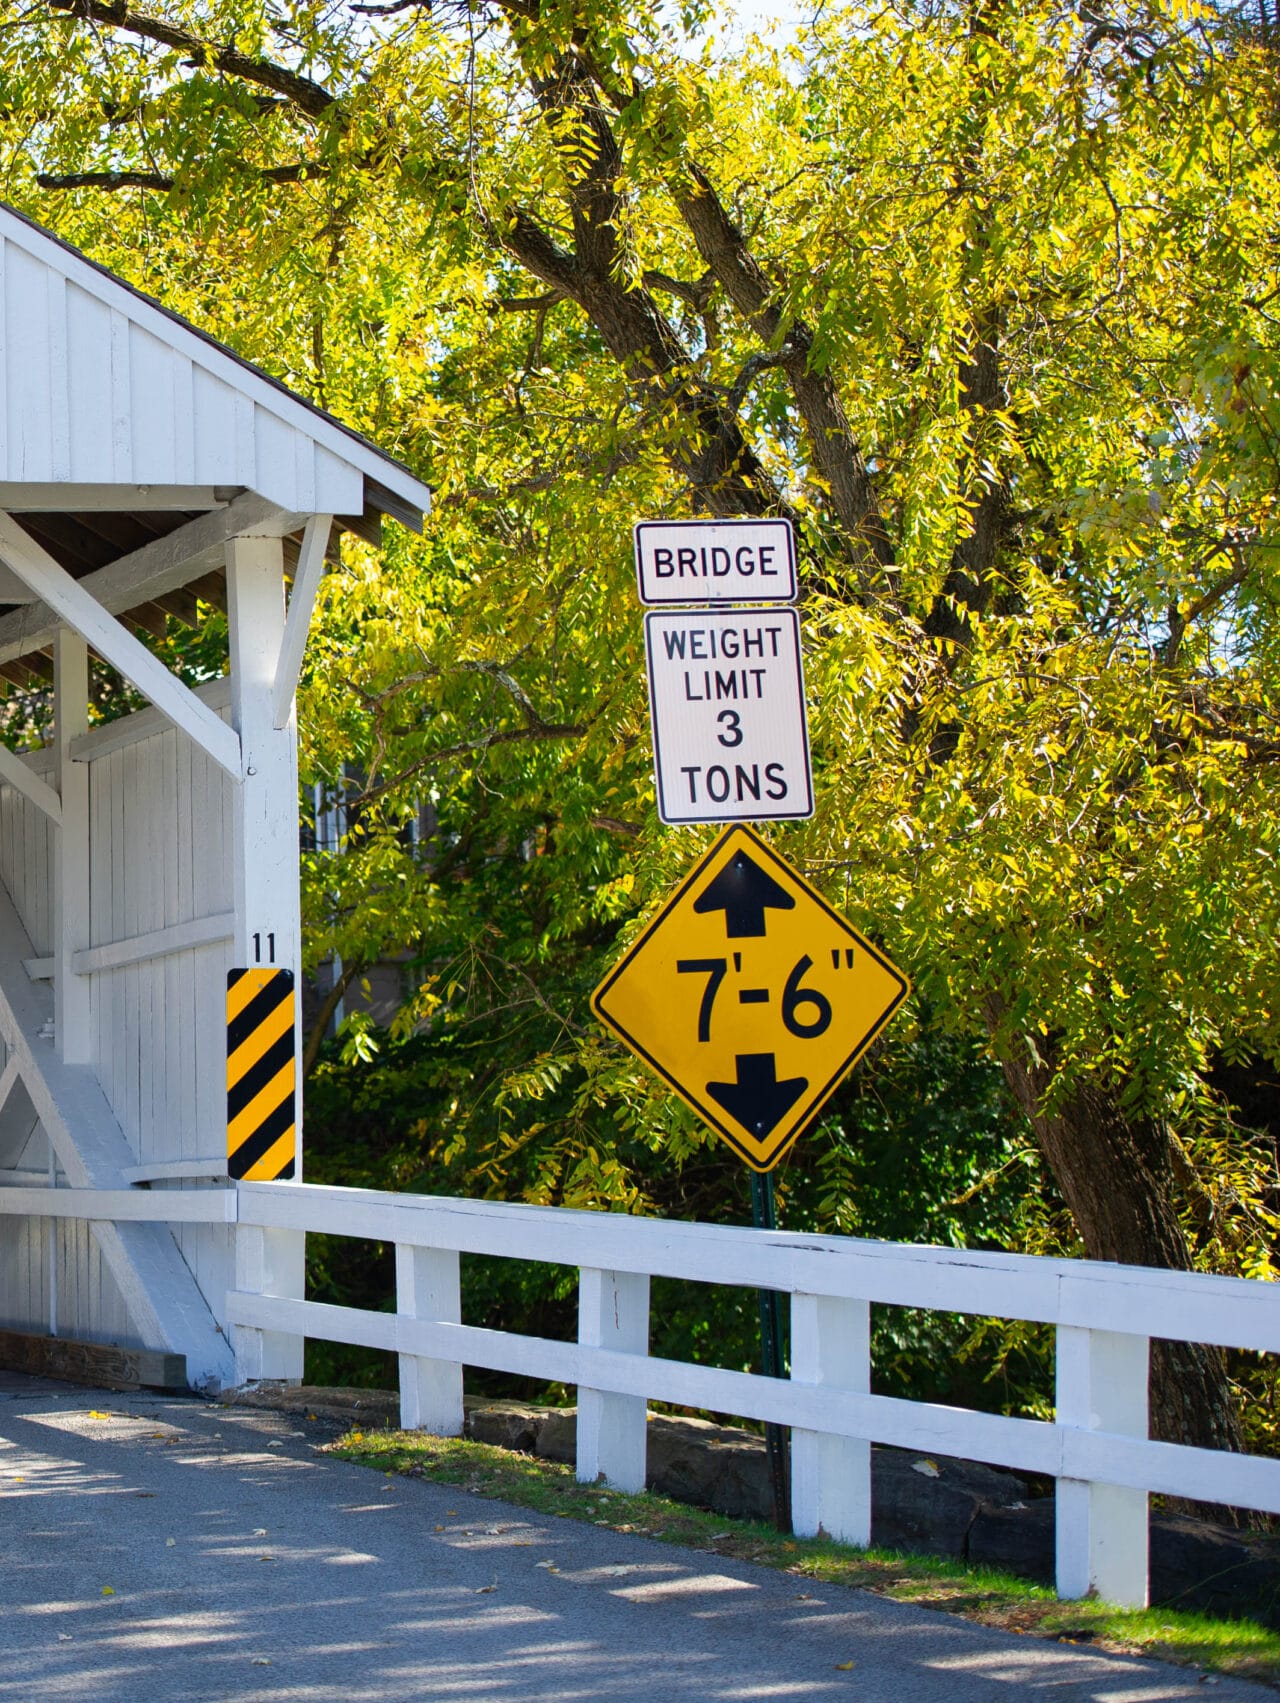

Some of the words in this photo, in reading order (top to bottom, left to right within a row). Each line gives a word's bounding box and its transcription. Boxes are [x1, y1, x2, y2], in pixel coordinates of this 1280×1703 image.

[655, 547, 778, 577] BRIDGE
[663, 627, 782, 660] WEIGHT
[684, 669, 767, 701] LIMIT
[717, 710, 744, 748] 3
[681, 763, 788, 804] TONS
[252, 932, 275, 963] 11
